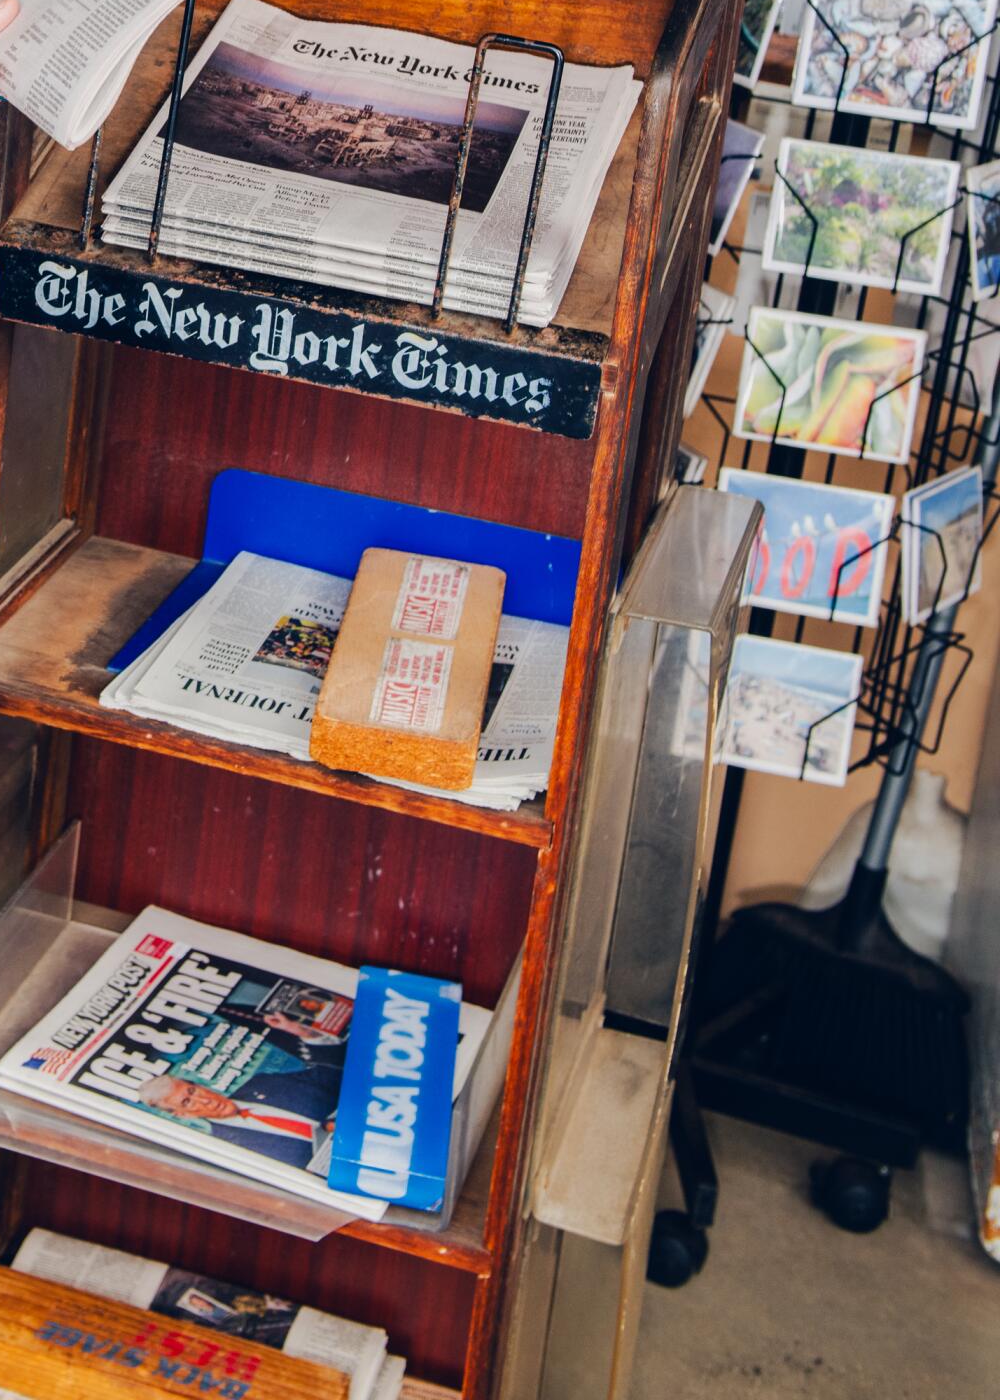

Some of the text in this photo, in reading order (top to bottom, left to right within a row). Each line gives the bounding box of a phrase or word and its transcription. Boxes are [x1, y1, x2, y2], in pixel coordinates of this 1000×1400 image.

[292, 39, 541, 95] The New York Times
[35, 260, 552, 414] The New York Times
[177, 673, 292, 714] JOURNAL.
[381, 680, 418, 726] MUSIC
[477, 747, 531, 761] THE
[52, 1014, 95, 1050] NEW
[81, 978, 124, 1028] YORK
[114, 955, 152, 1000] POST
[78, 1042, 172, 1103] ICE
[125, 1023, 194, 1055] &
[364, 987, 431, 1146] USA TODAY
[34, 1319, 252, 1400] BACK STAGE
[133, 1322, 263, 1382] WEST
